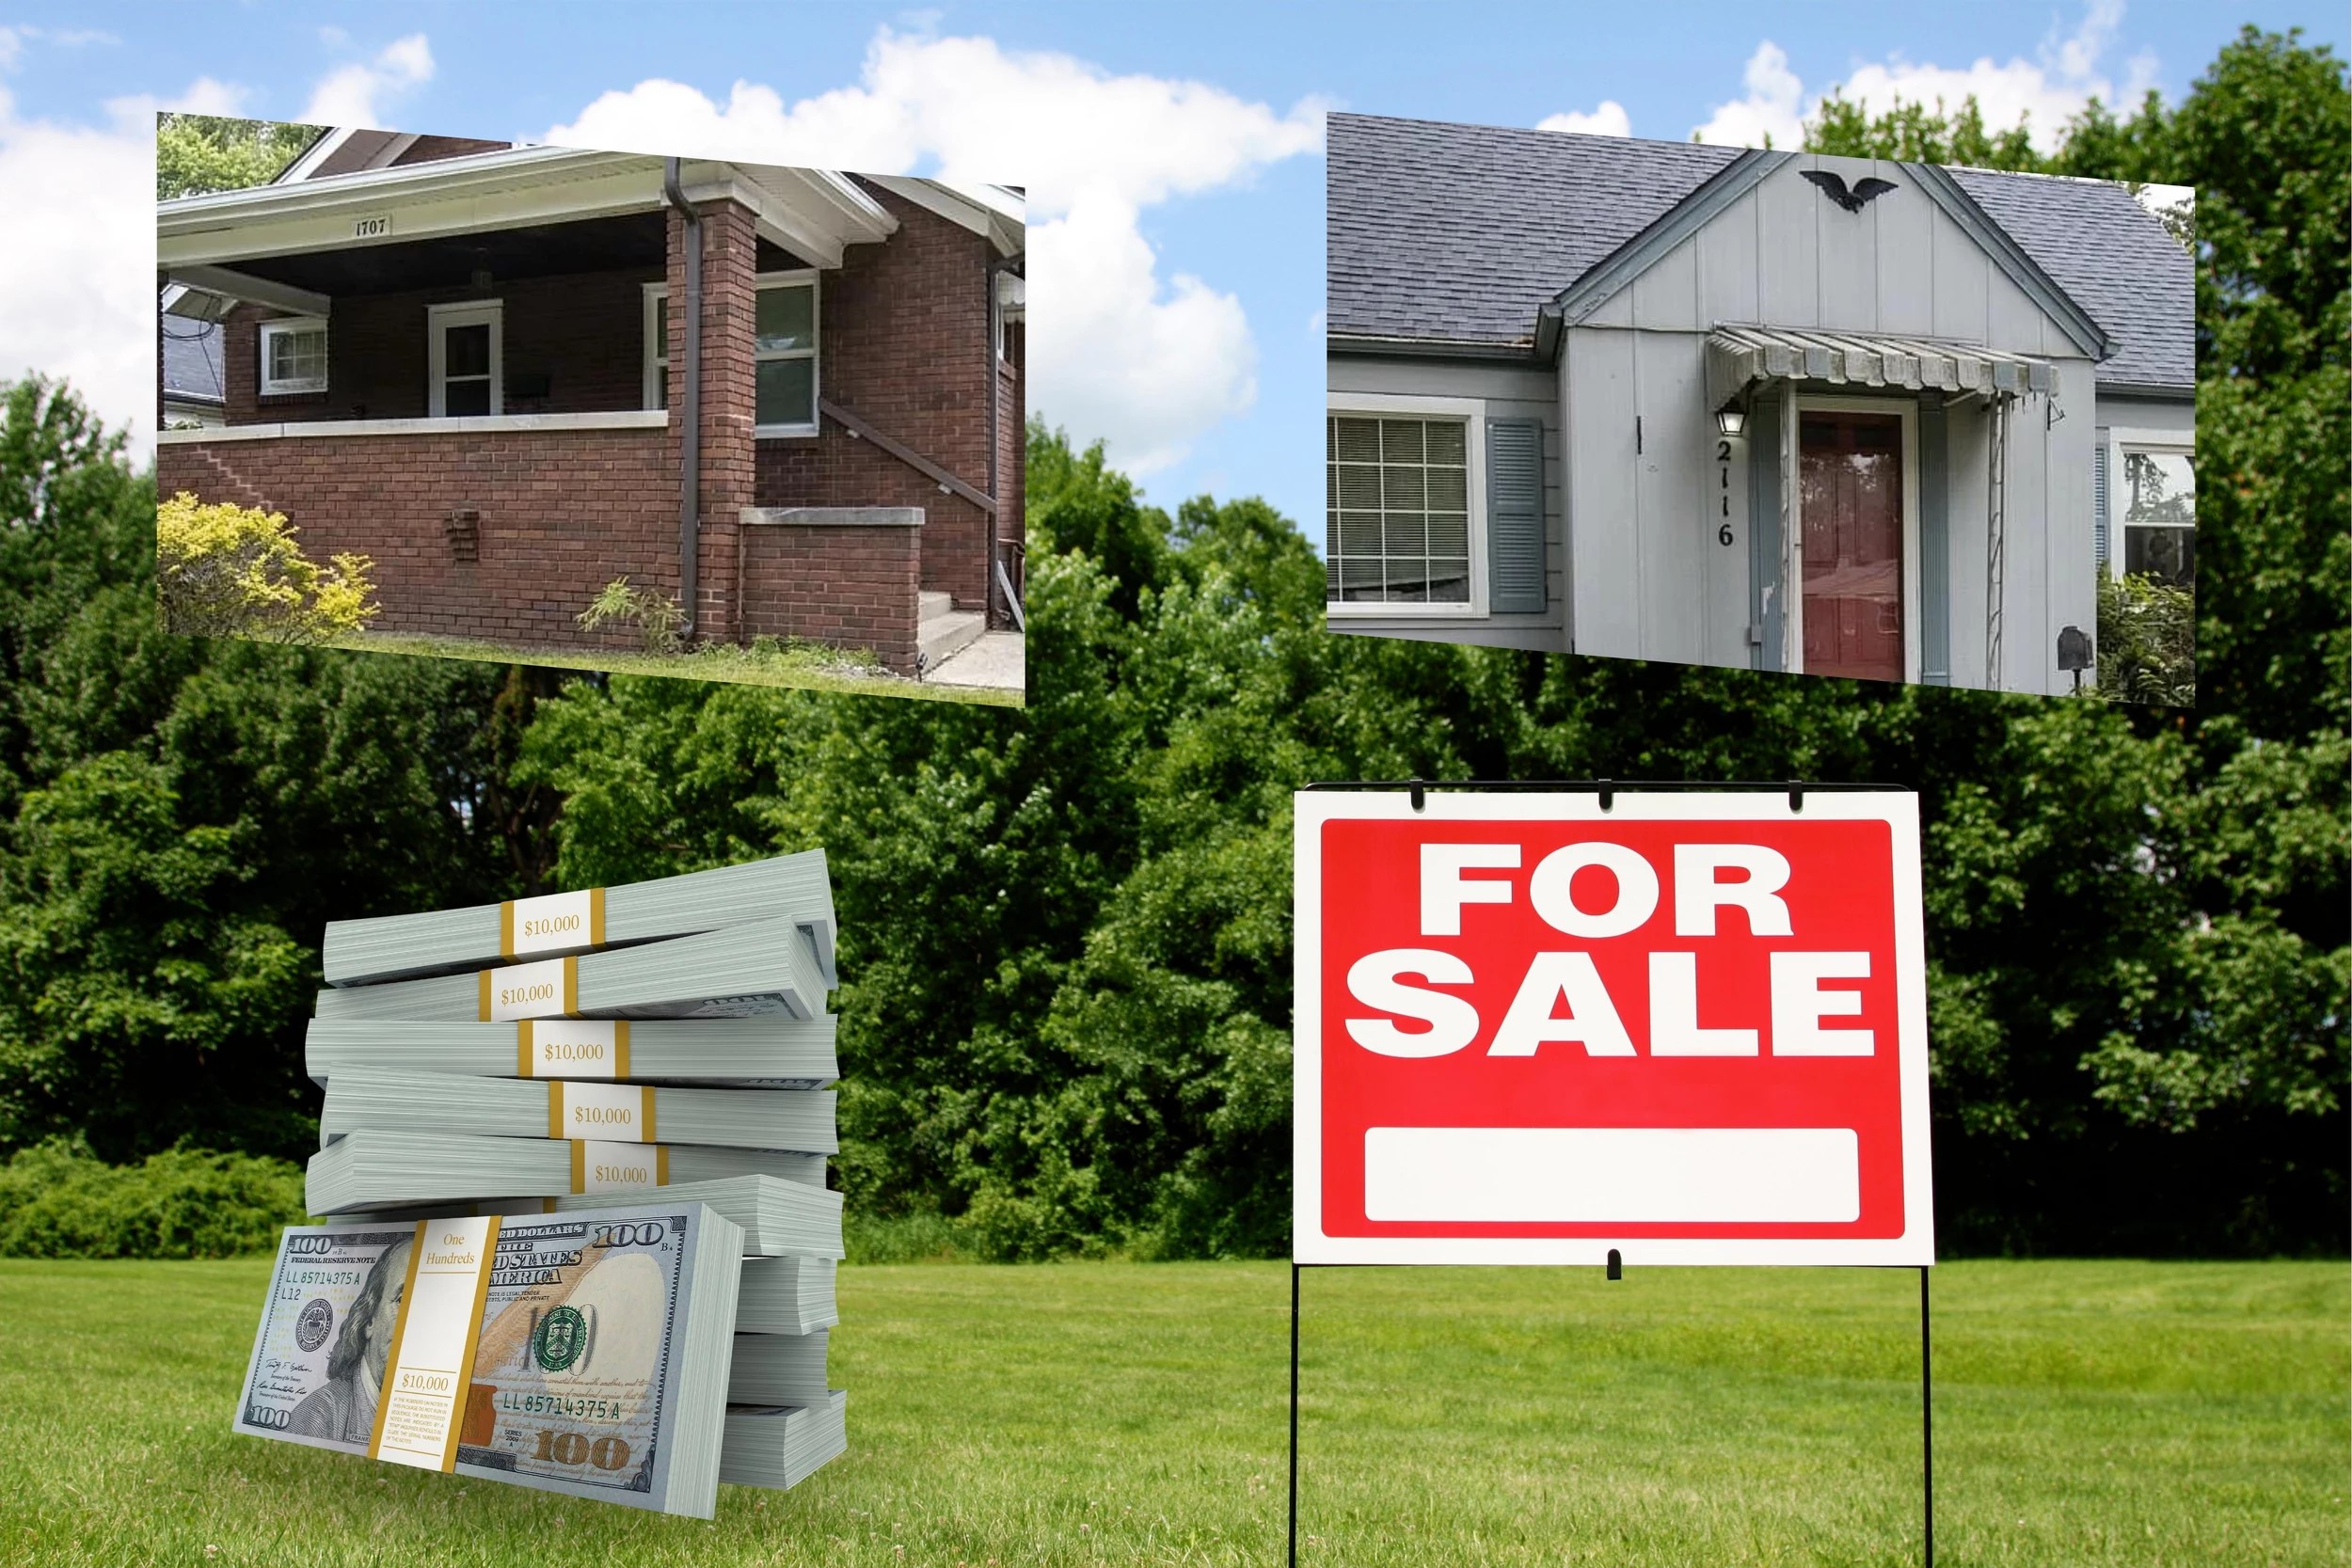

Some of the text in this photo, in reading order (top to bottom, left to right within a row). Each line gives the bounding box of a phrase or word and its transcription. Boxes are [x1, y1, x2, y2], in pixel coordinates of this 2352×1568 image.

[357, 218, 386, 236] 1707
[1717, 440, 1734, 546] 2116
[1420, 841, 1795, 939] FOR
[524, 914, 580, 938] $10,000
[501, 983, 553, 1006] $10,000
[1344, 948, 1875, 1059] SALE
[545, 1043, 604, 1062] $10,000
[575, 1106, 631, 1125] $10,000
[596, 1164, 647, 1186] $10,000
[443, 1233, 465, 1245] One
[517, 1224, 584, 1238] DOLLARS
[592, 1222, 664, 1248] 100
[289, 1237, 332, 1255] 100
[496, 1243, 533, 1253] THE
[426, 1252, 475, 1264] Hundreds
[509, 1250, 582, 1271] STATES
[286, 1271, 360, 1285] LL 85714375 A
[488, 1269, 562, 1287] MERICA
[281, 1288, 301, 1300] L12
[402, 1373, 449, 1391] $10,000
[503, 1393, 520, 1410] LL
[525, 1396, 607, 1418] 85714375
[612, 1402, 619, 1419] A
[249, 1405, 291, 1430] 100
[350, 1433, 370, 1443] FRANK
[531, 1430, 630, 1471] 100
